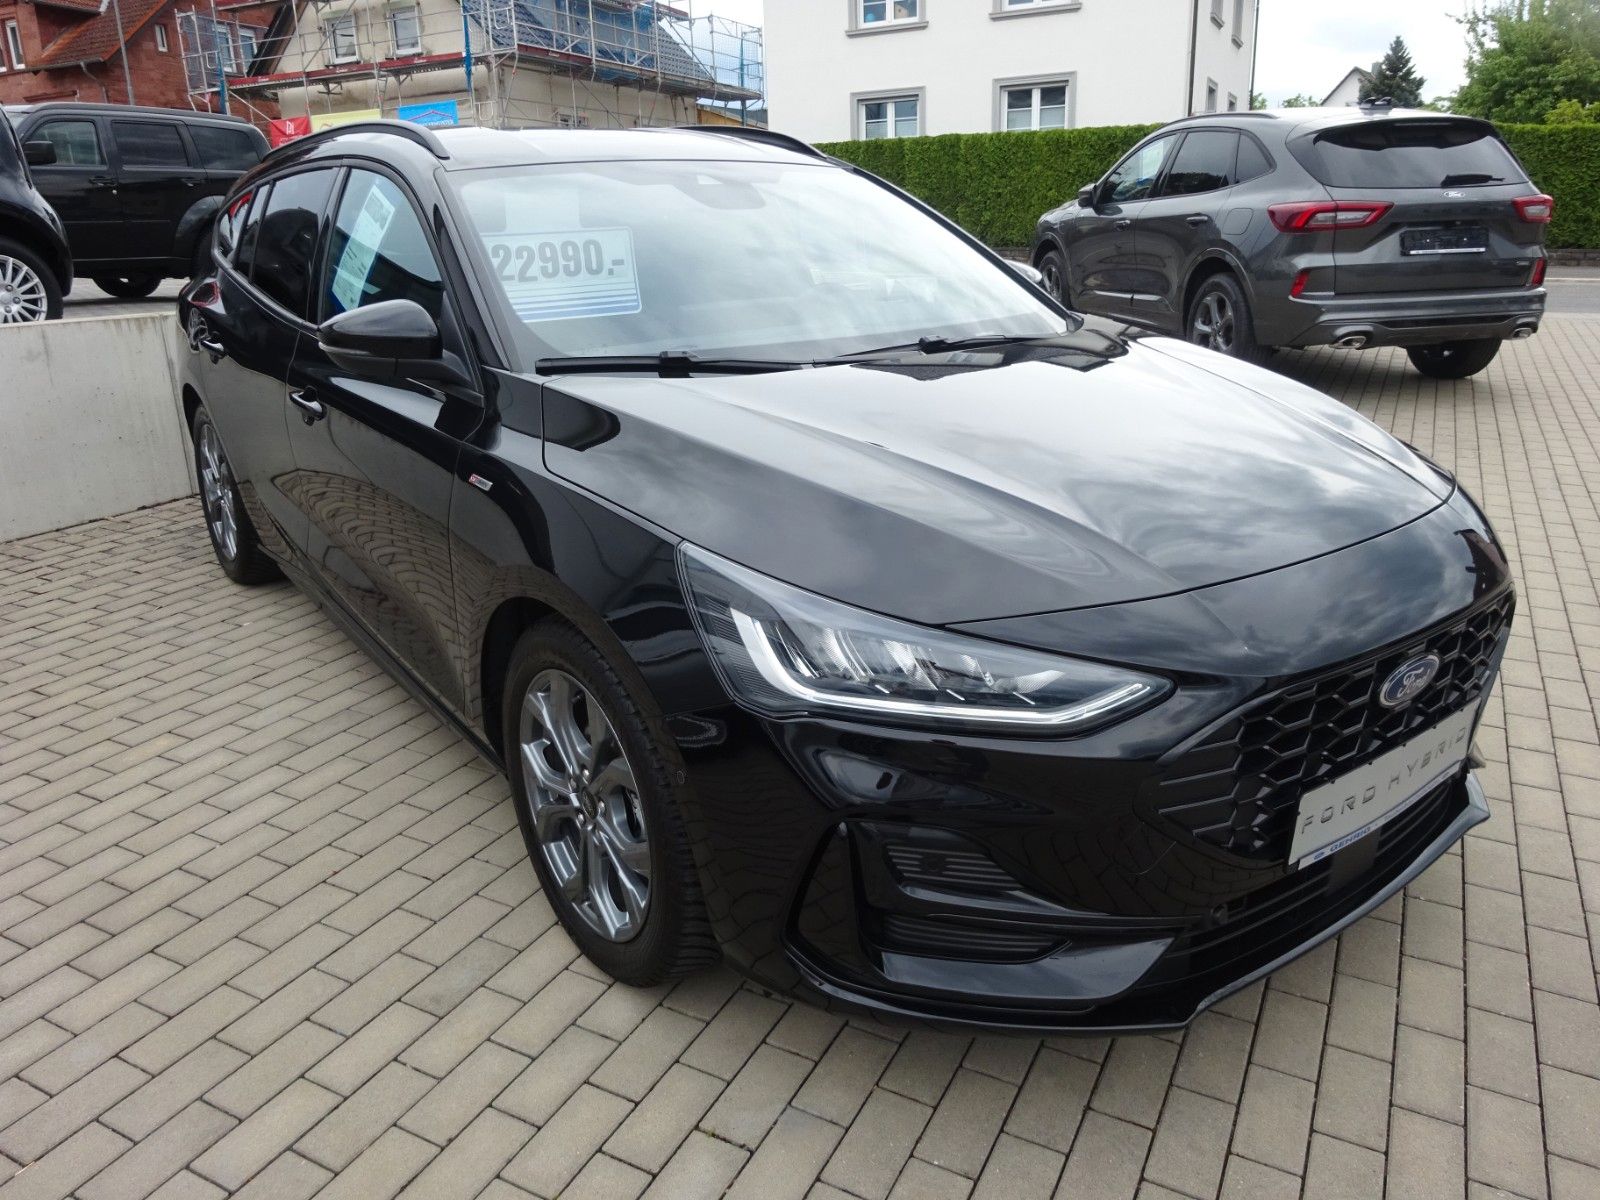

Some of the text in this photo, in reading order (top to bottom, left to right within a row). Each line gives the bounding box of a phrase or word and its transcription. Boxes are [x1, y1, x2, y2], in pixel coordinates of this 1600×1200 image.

[491, 238, 625, 283] 22990.-
[1396, 666, 1431, 698] Ford
[1301, 785, 1377, 835] FORD
[1387, 726, 1467, 791] HYBRID
